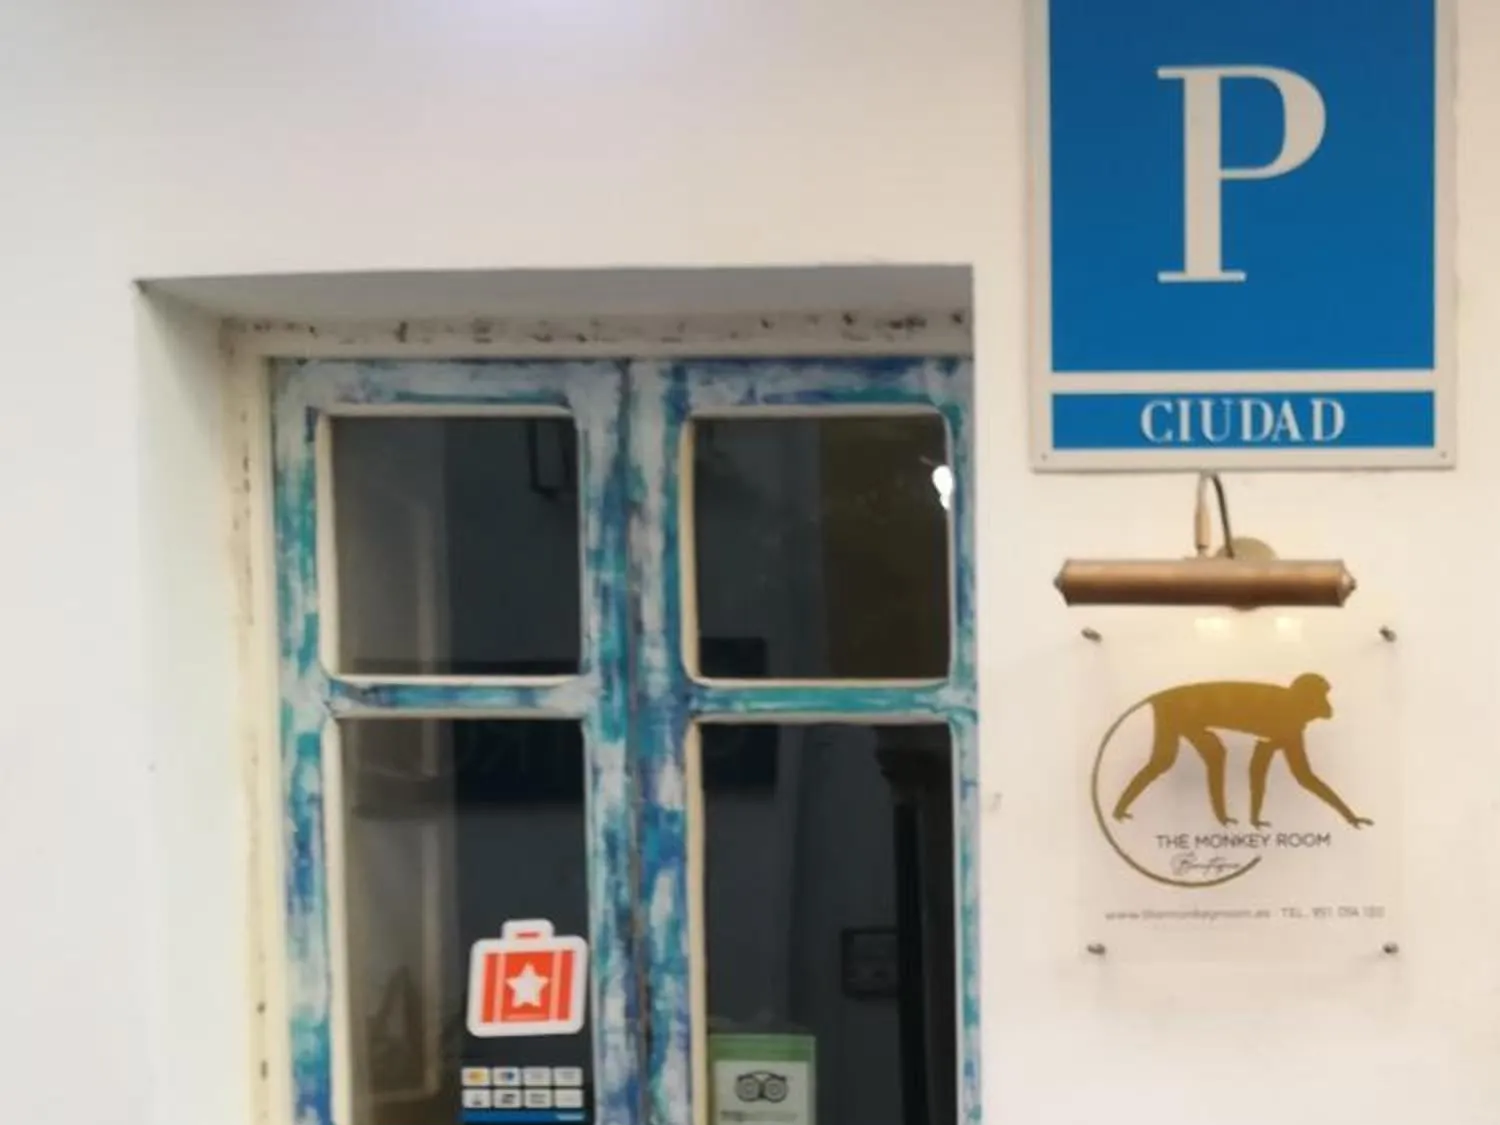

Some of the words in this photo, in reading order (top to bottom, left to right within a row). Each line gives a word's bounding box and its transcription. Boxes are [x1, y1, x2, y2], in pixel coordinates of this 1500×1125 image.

[1156, 65, 1327, 283] P
[1139, 398, 1346, 443] CIUDAD
[1156, 834, 1190, 850] THE
[1195, 833, 1272, 849] MONKEY
[1276, 831, 1332, 848] ROOM
